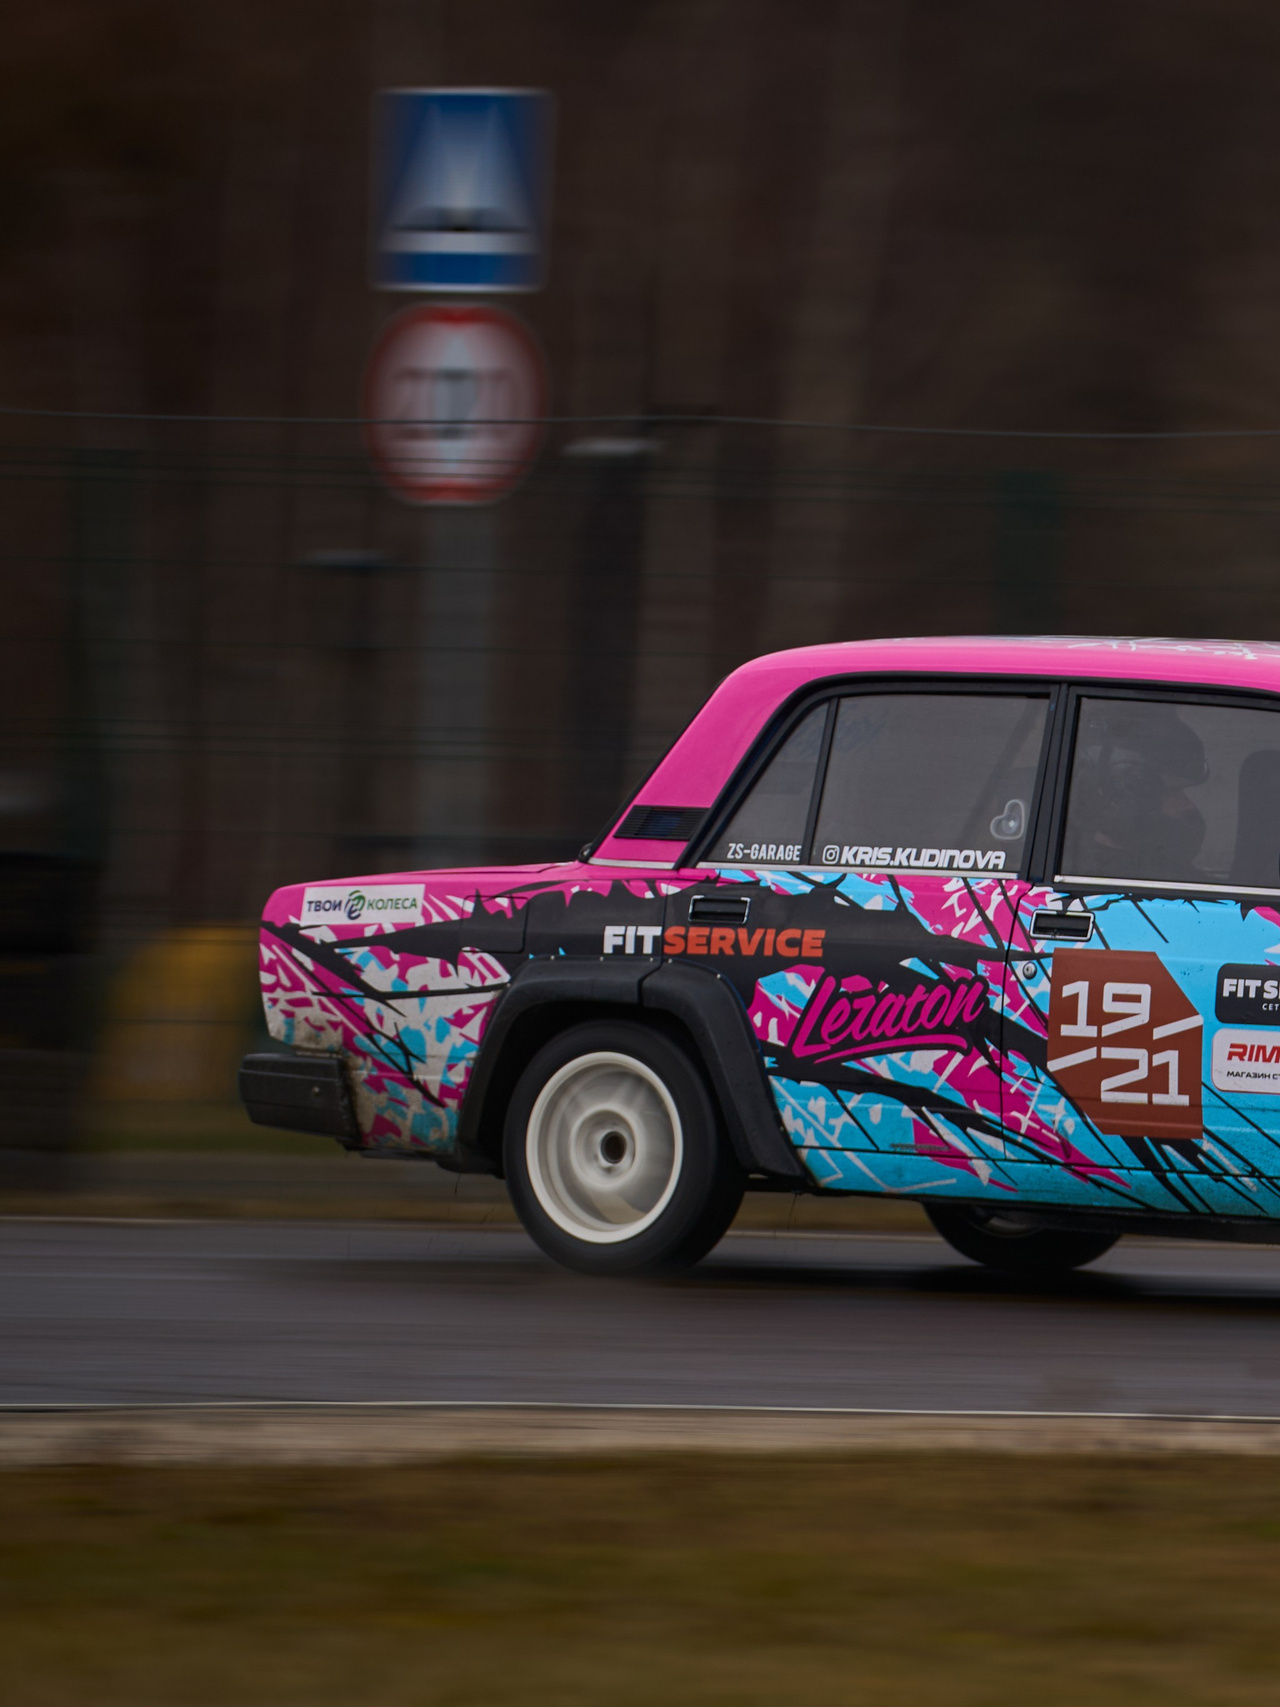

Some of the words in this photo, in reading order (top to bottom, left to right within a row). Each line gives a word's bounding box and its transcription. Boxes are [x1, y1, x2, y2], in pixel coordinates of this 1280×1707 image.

[726, 842, 802, 862] ZS-GARAGE
[840, 845, 1007, 870] KRIS.KUDINOVA
[306, 900, 343, 913] ТВОИ
[366, 897, 418, 911] КОЛЕСА
[1226, 1070, 1272, 1081] МАГАЗИН
